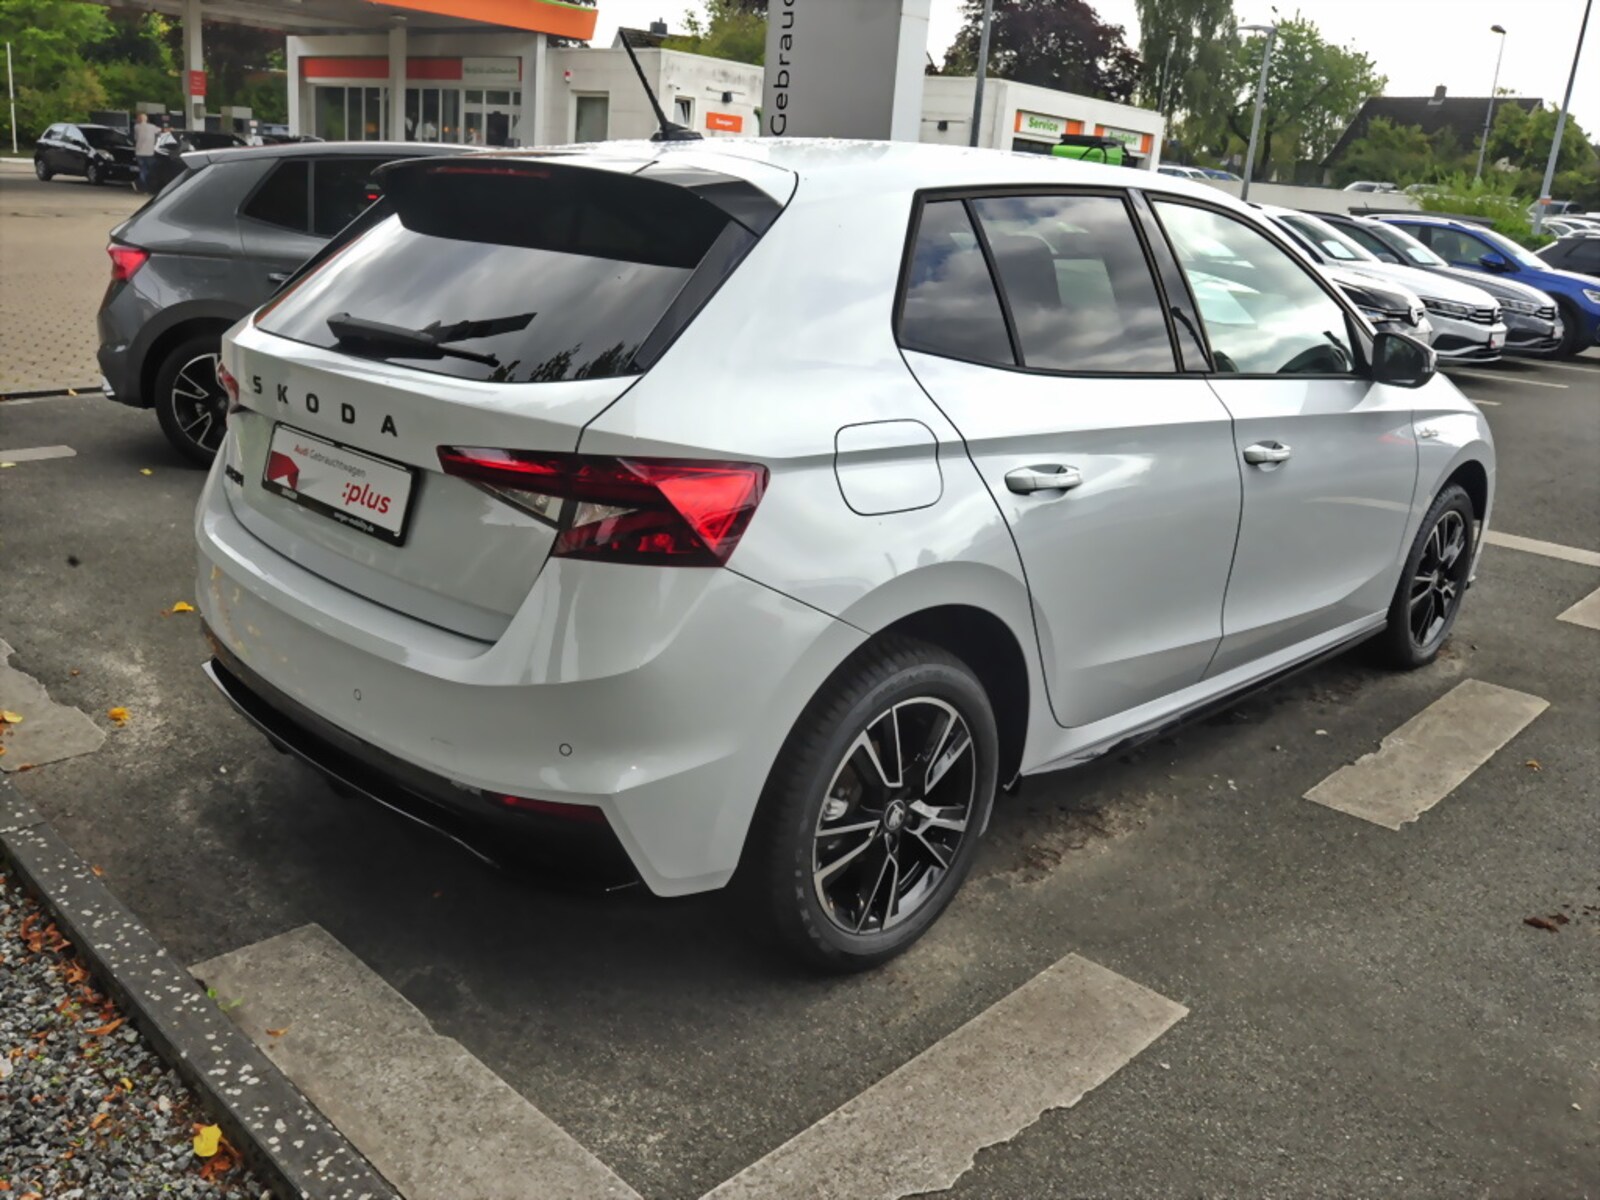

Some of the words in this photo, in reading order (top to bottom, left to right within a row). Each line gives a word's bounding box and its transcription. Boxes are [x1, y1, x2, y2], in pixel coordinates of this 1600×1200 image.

[1028, 116, 1059, 133] Service
[252, 375, 399, 438] SKODA
[294, 444, 309, 457] Audi
[310, 449, 367, 478] Gebrauchtwagen
[341, 481, 393, 515] :plus
